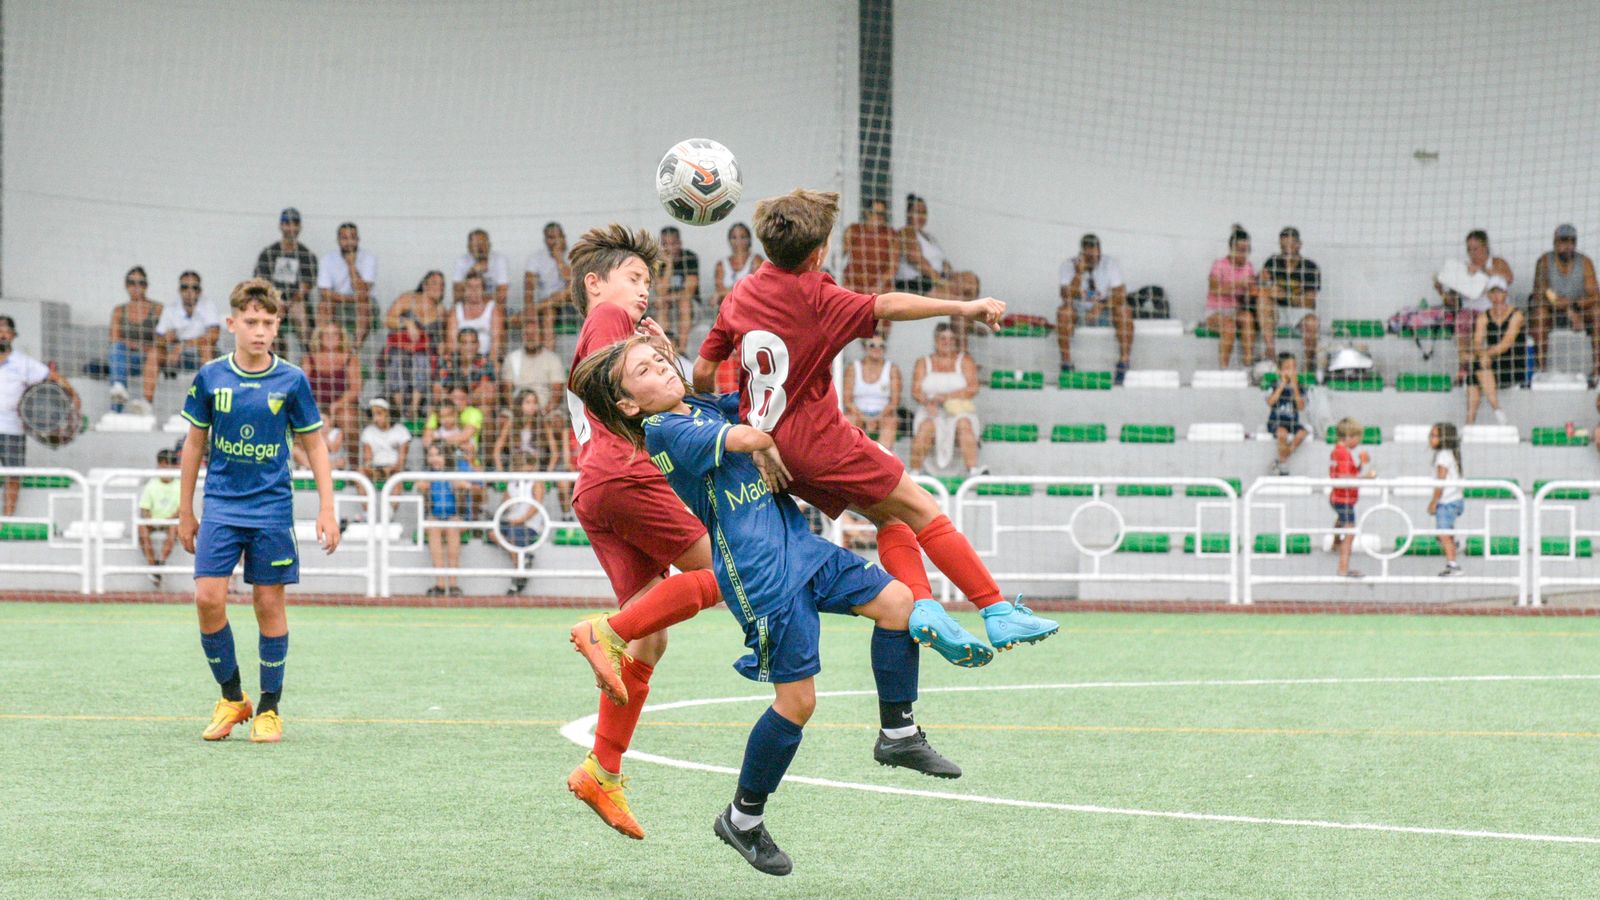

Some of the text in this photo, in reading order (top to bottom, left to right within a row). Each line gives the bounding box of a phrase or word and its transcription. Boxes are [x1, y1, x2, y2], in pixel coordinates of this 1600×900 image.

[741, 330, 789, 432] 8
[214, 388, 232, 413] 10
[215, 434, 280, 460] Madegar
